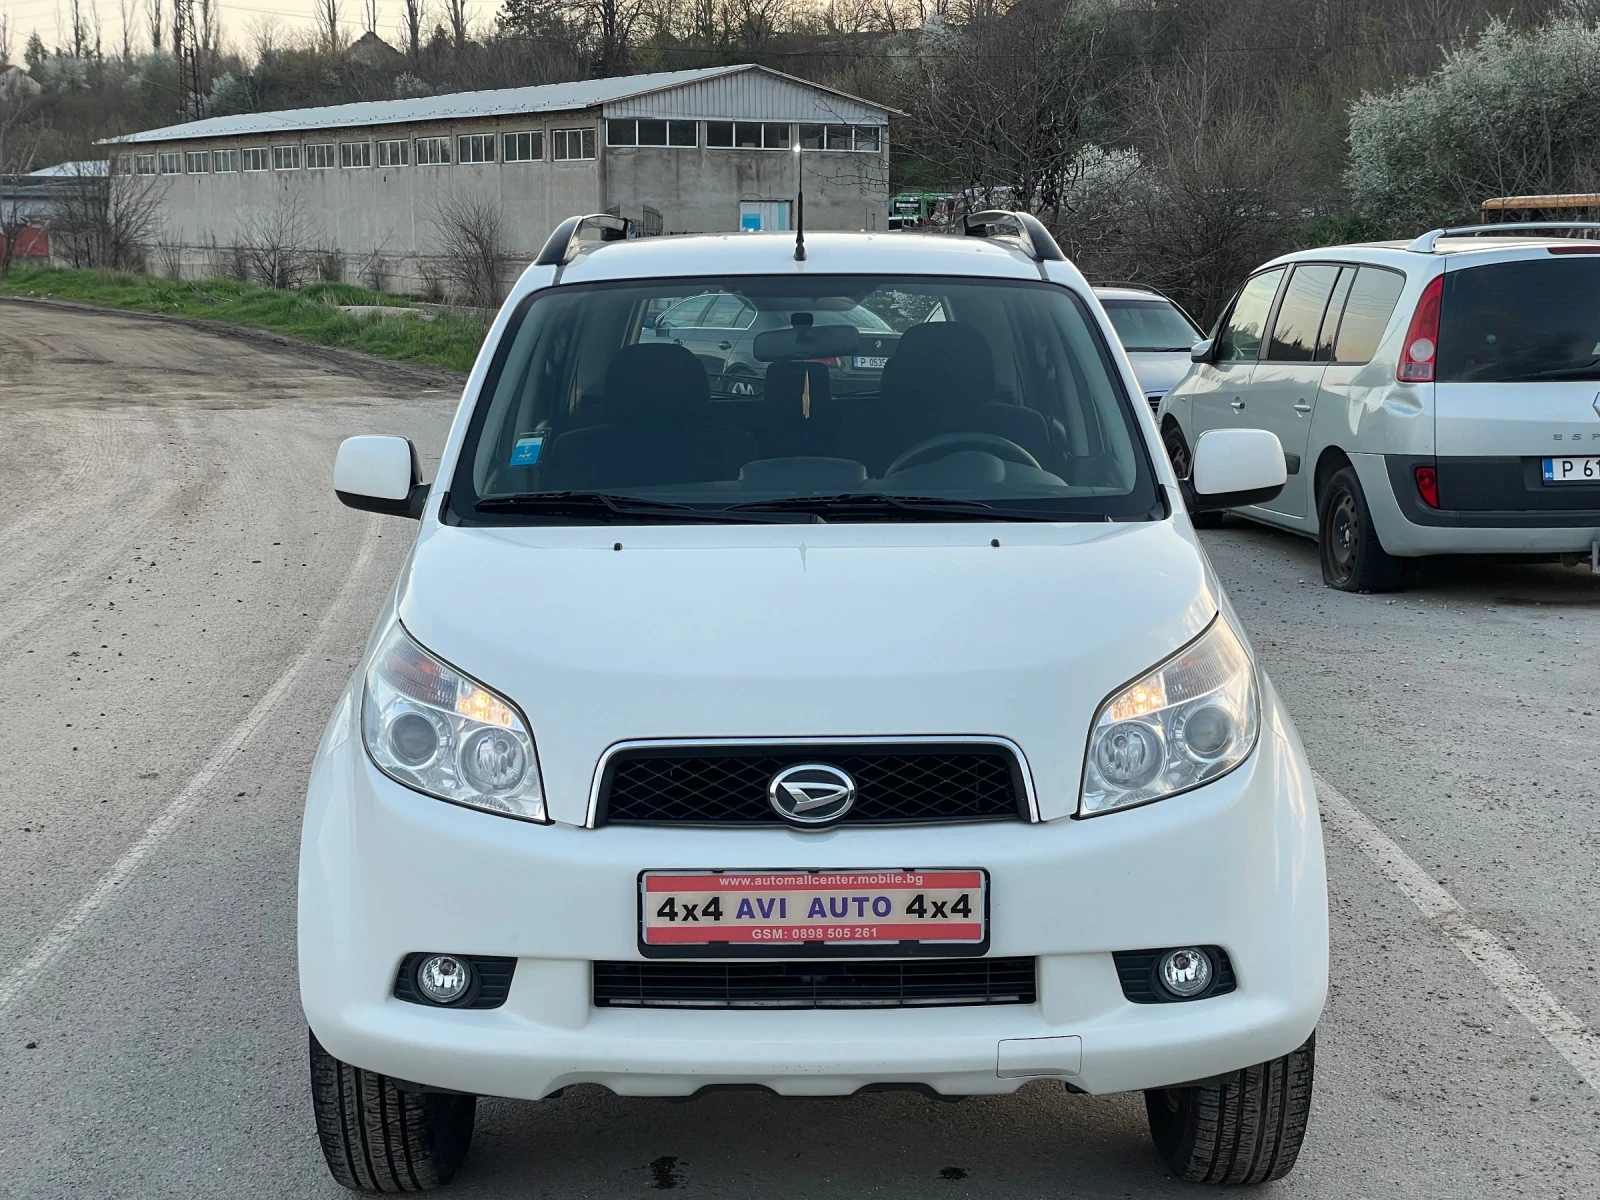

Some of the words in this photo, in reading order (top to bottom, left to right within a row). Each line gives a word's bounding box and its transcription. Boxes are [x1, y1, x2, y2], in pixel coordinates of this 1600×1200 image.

[1562, 460, 1573, 478] P
[719, 873, 924, 886] www.automallcenter.mobile.bg
[656, 896, 724, 922] 4x4
[735, 897, 787, 920] AVI
[807, 896, 892, 919] AUTO
[905, 893, 972, 919] 4x4
[751, 929, 788, 940] GSM:
[792, 928, 824, 940] 0898
[827, 928, 851, 939] 505
[854, 927, 878, 938] 261
